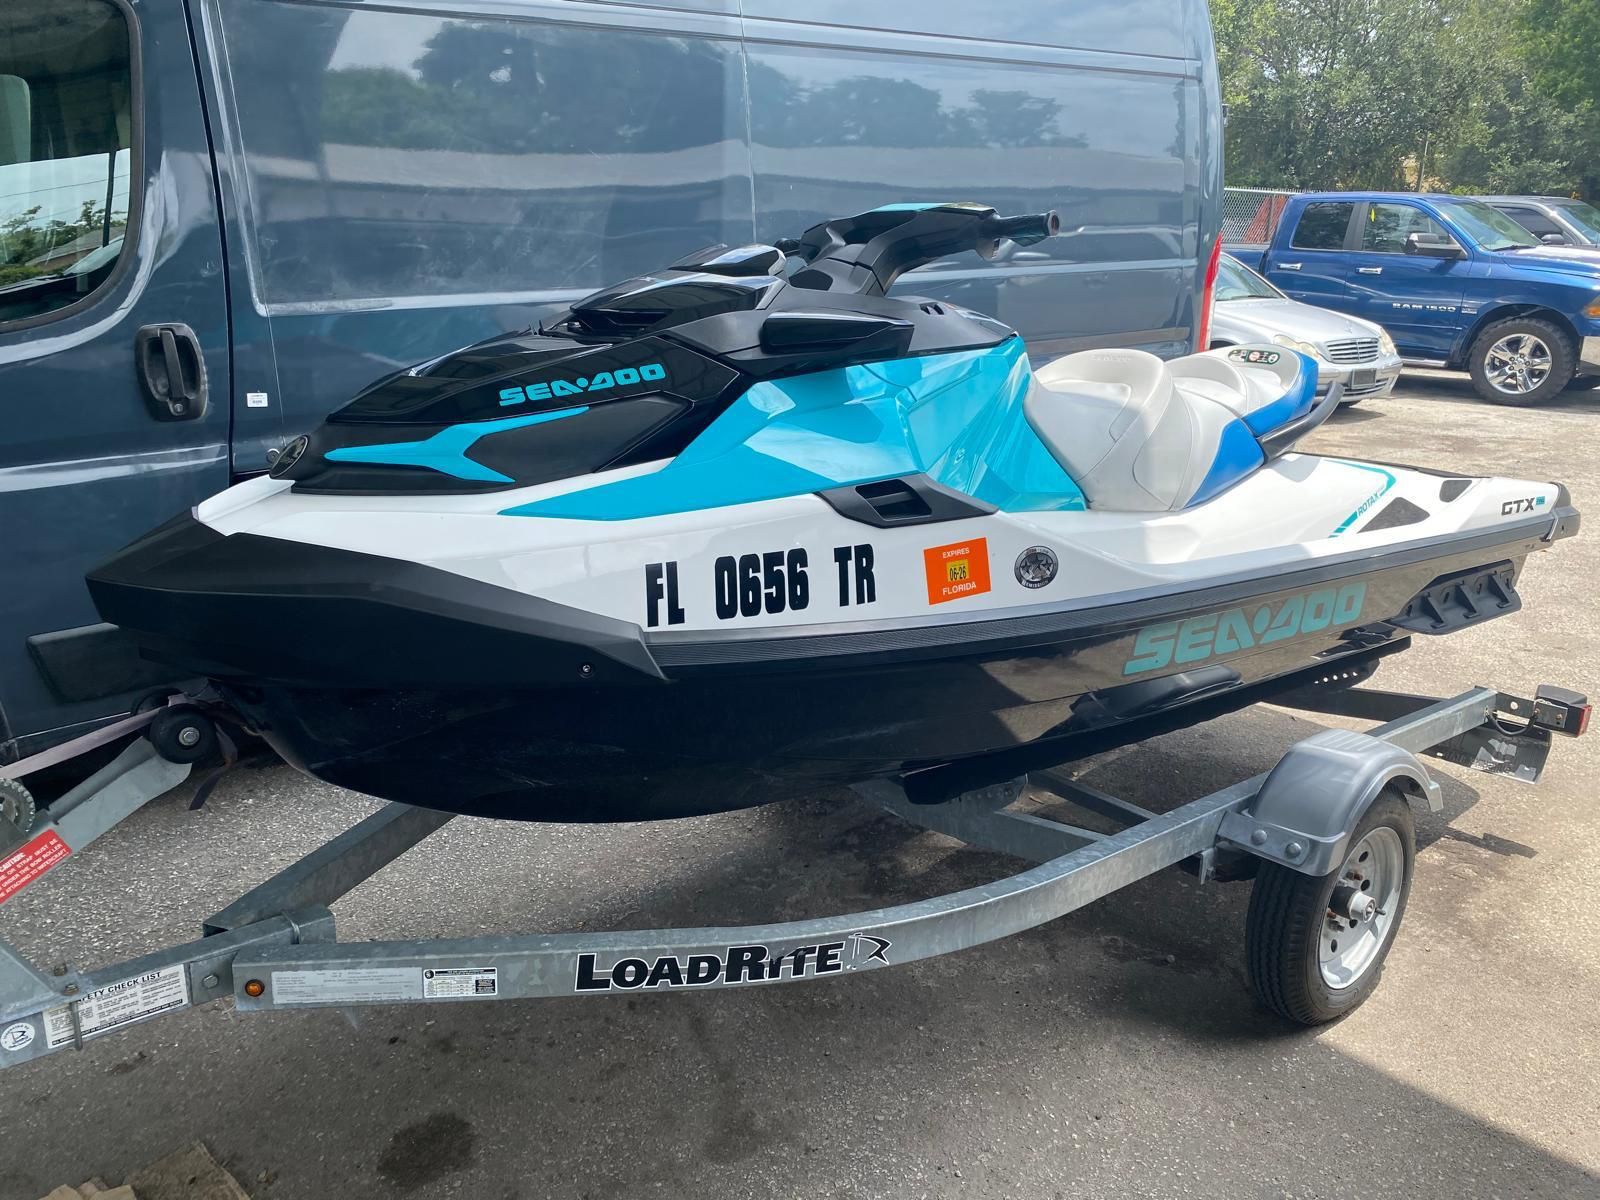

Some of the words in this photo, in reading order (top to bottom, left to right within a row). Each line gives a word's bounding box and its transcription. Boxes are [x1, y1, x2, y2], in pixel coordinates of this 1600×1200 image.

[1392, 303, 1423, 311] RAM
[1425, 305, 1457, 313] 1500
[1357, 491, 1380, 517] ROTAX
[1501, 497, 1535, 516] GTX
[942, 547, 970, 559] EXPIRES
[949, 565, 967, 582] 06-26
[645, 560, 685, 628] FL
[714, 547, 810, 621] 0656
[833, 543, 877, 608] TR
[942, 581, 977, 596] FLORIDA
[107, 978, 140, 993] CHECK
[141, 971, 162, 983] LIST
